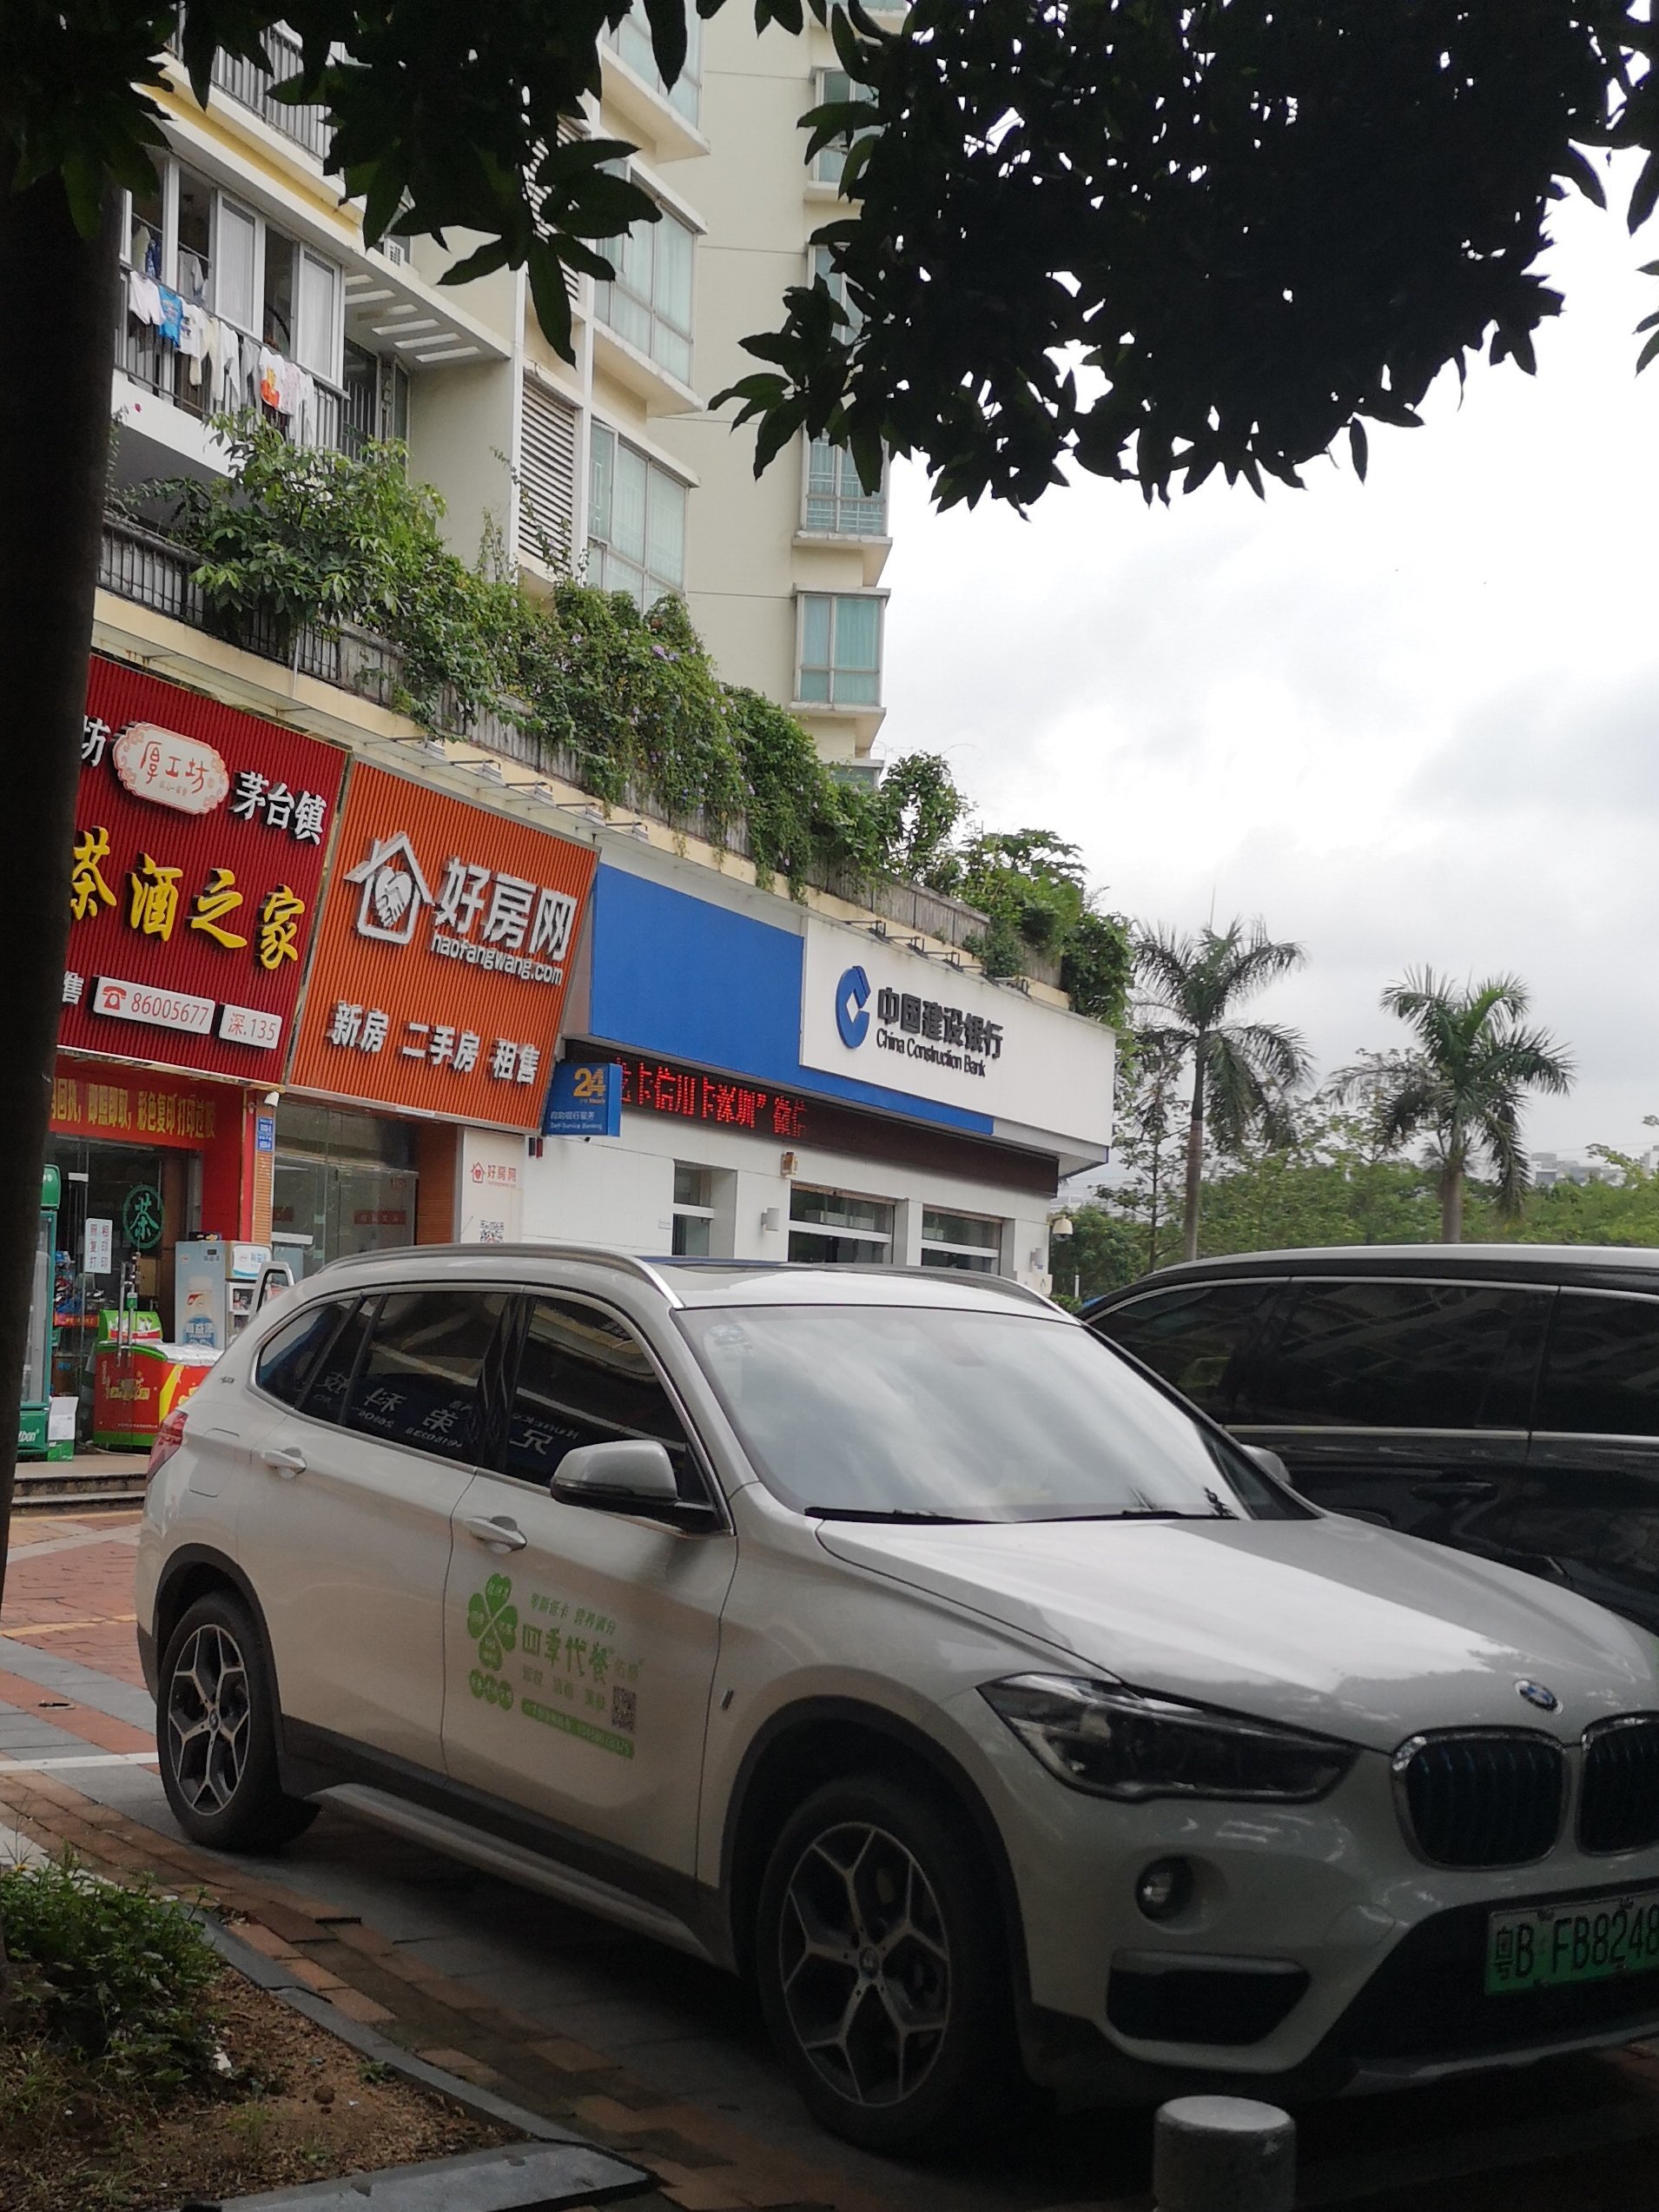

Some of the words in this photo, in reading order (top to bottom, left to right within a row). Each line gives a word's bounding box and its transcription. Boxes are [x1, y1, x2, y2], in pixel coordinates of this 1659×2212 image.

[139, 739, 210, 795] 厚工坊
[234, 771, 327, 846] 茅台镇
[69, 827, 306, 970] 茶酒之家
[434, 856, 578, 963] 好房网
[430, 932, 564, 986] haofangwang.com
[62, 970, 84, 1005] 售
[130, 991, 210, 1027] 86005677
[330, 1000, 389, 1054] 新房
[401, 1022, 479, 1074] 二手房
[492, 1039, 540, 1085] 租售
[877, 986, 1004, 1060] 中国建设银行
[876, 1028, 905, 1053] China
[907, 1037, 962, 1072] Construction
[963, 1054, 987, 1078] Bank
[572, 1067, 606, 1097] 24
[486, 1163, 517, 1182] 好房网
